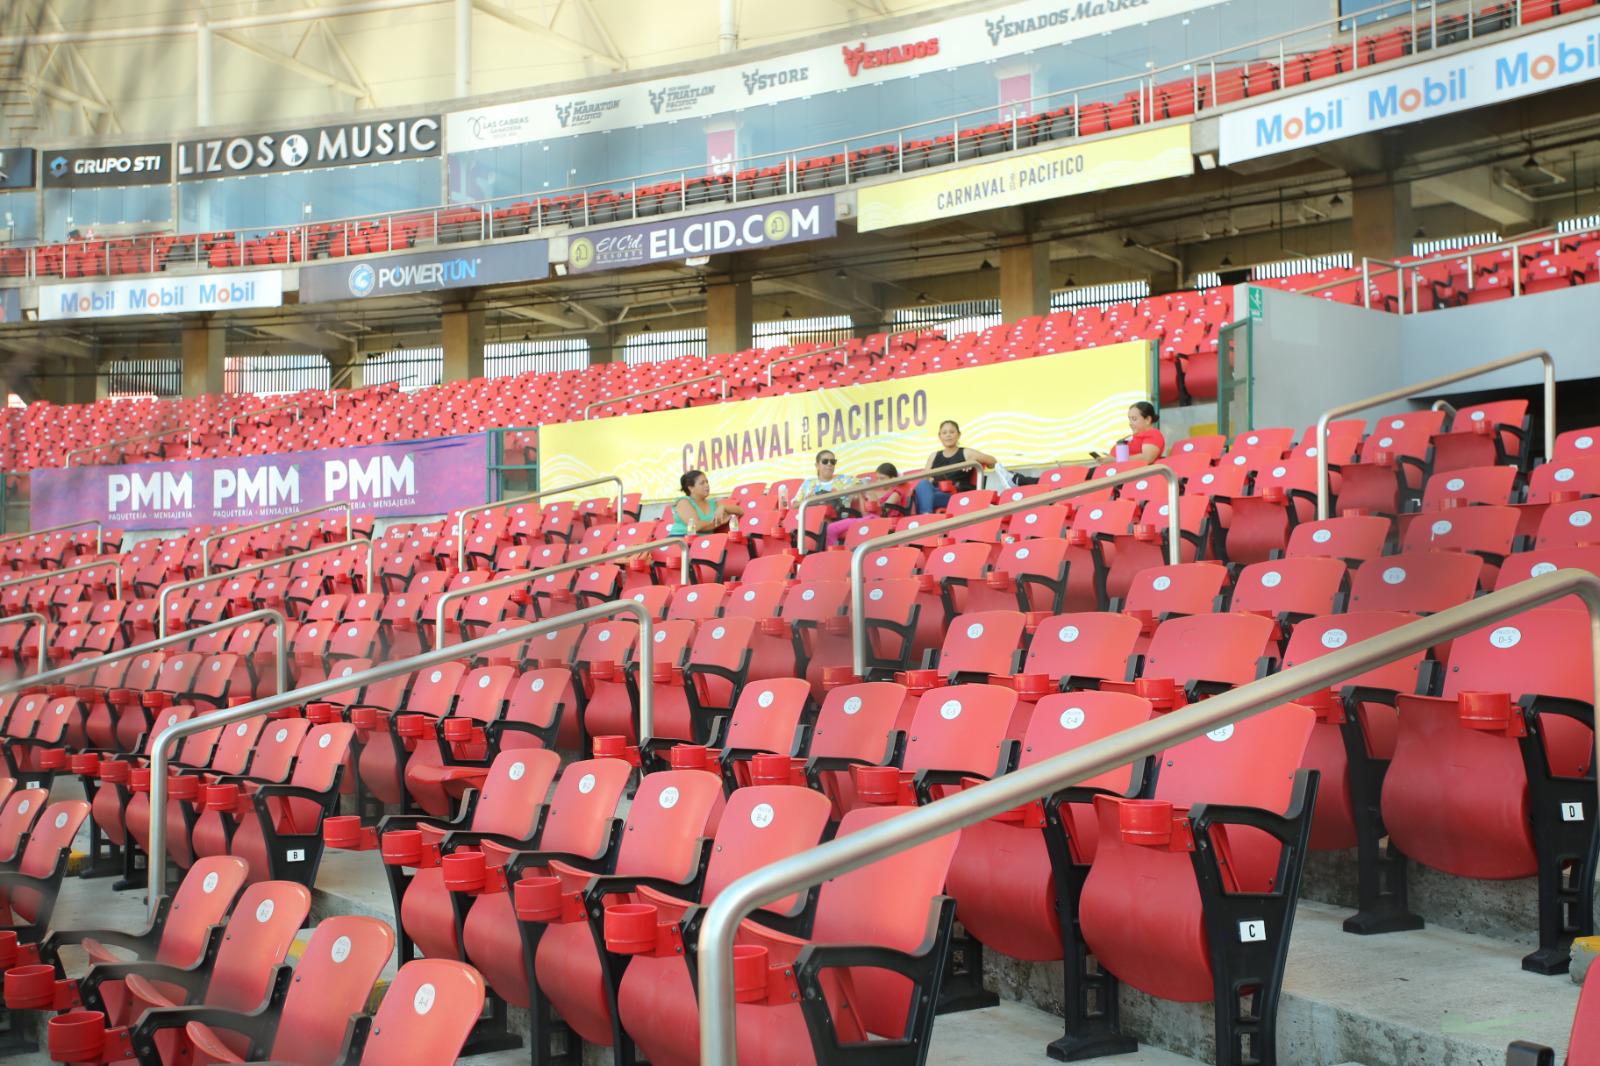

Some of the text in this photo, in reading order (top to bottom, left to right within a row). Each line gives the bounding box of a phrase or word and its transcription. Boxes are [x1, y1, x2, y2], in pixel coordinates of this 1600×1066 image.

[1071, 0, 1150, 21] Marke
[758, 66, 809, 90] STORE
[1368, 68, 1467, 120] Mobil
[1256, 100, 1343, 147] Mobil
[178, 117, 440, 176] LIZOS MUSIC
[74, 155, 161, 175] GRUPO STI
[937, 176, 1006, 210] CARNAVAL
[1019, 154, 1084, 188] PACIFICO
[596, 237, 617, 252] El
[61, 291, 115, 313] Mobil
[128, 285, 185, 309] Mobil
[199, 281, 255, 306] Mobil
[682, 421, 794, 473] CARNAVAL
[817, 389, 927, 448] PACIFICO
[213, 464, 300, 509] PMM
[324, 452, 415, 502] PMM
[108, 470, 192, 512] PMM
[1569, 804, 1576, 818] D
[293, 851, 299, 861] B
[1248, 923, 1256, 939] C
